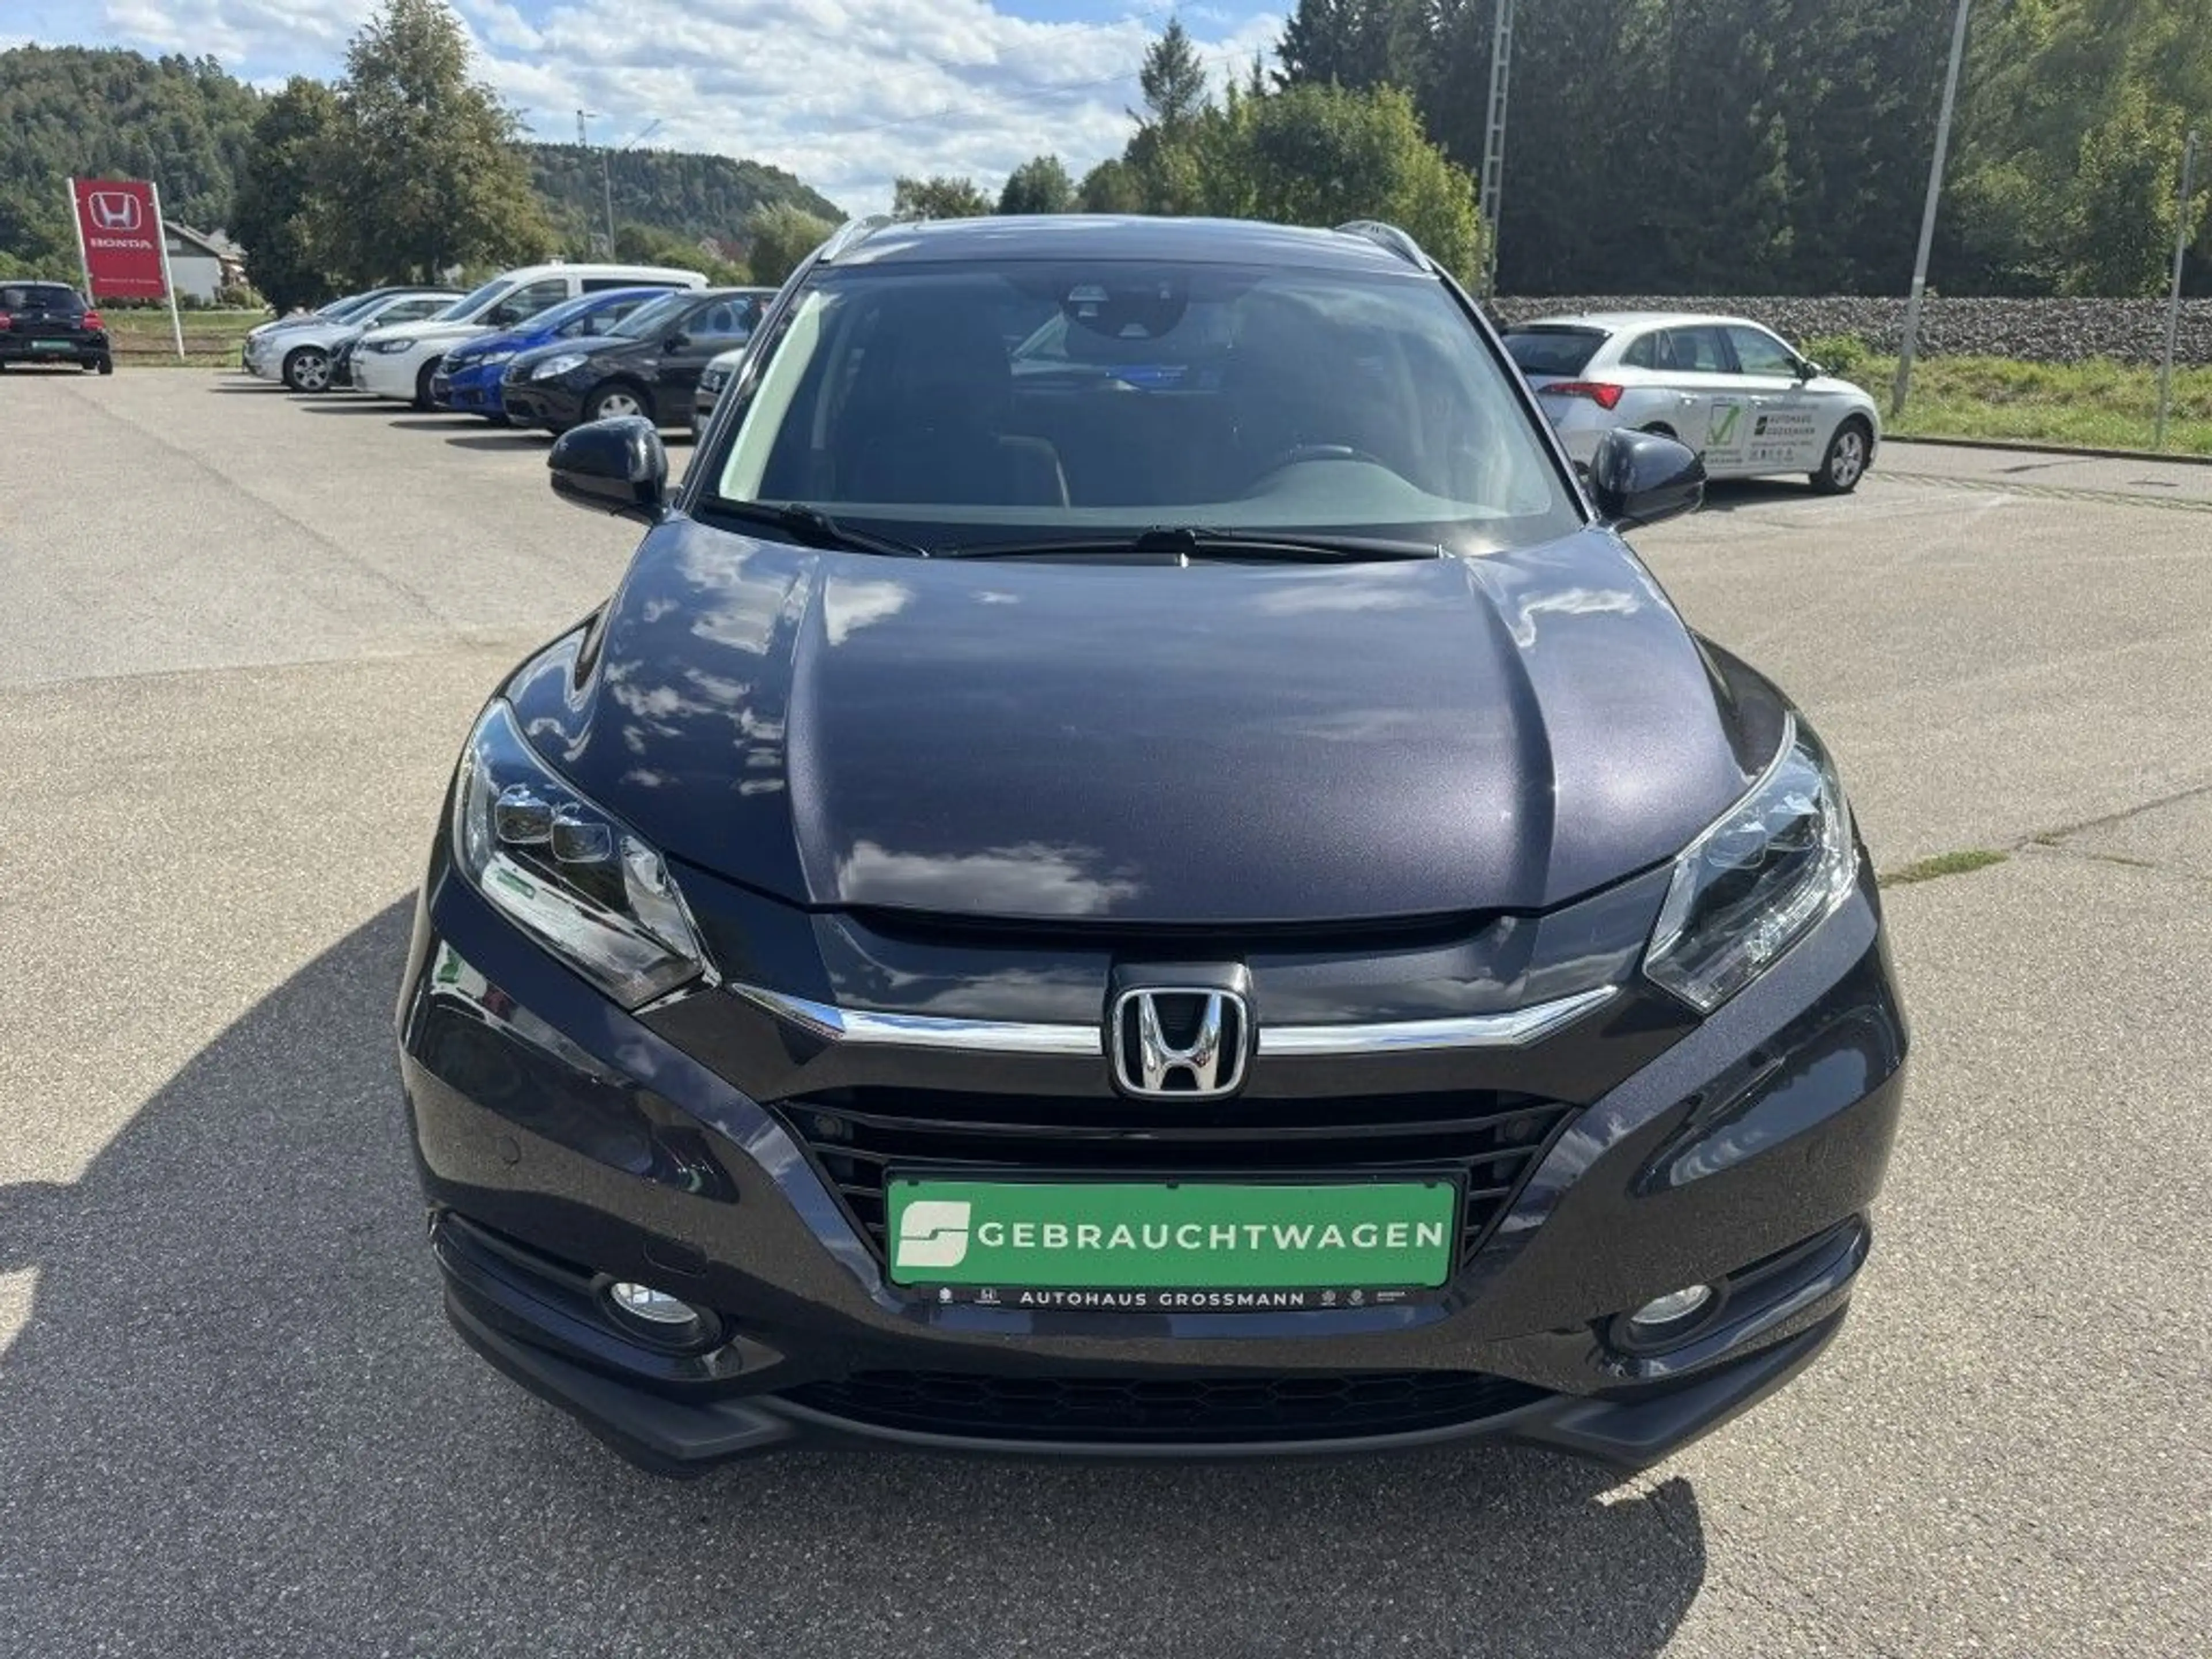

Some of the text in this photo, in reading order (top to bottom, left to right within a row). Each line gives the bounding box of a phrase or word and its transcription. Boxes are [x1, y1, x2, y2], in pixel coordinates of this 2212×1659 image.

[90, 237, 153, 249] HONDA
[979, 1223, 1441, 1248] GEBRAUCHTWAGEN
[1021, 1292, 1303, 1305] AUTOHAUS GROSSMANN
